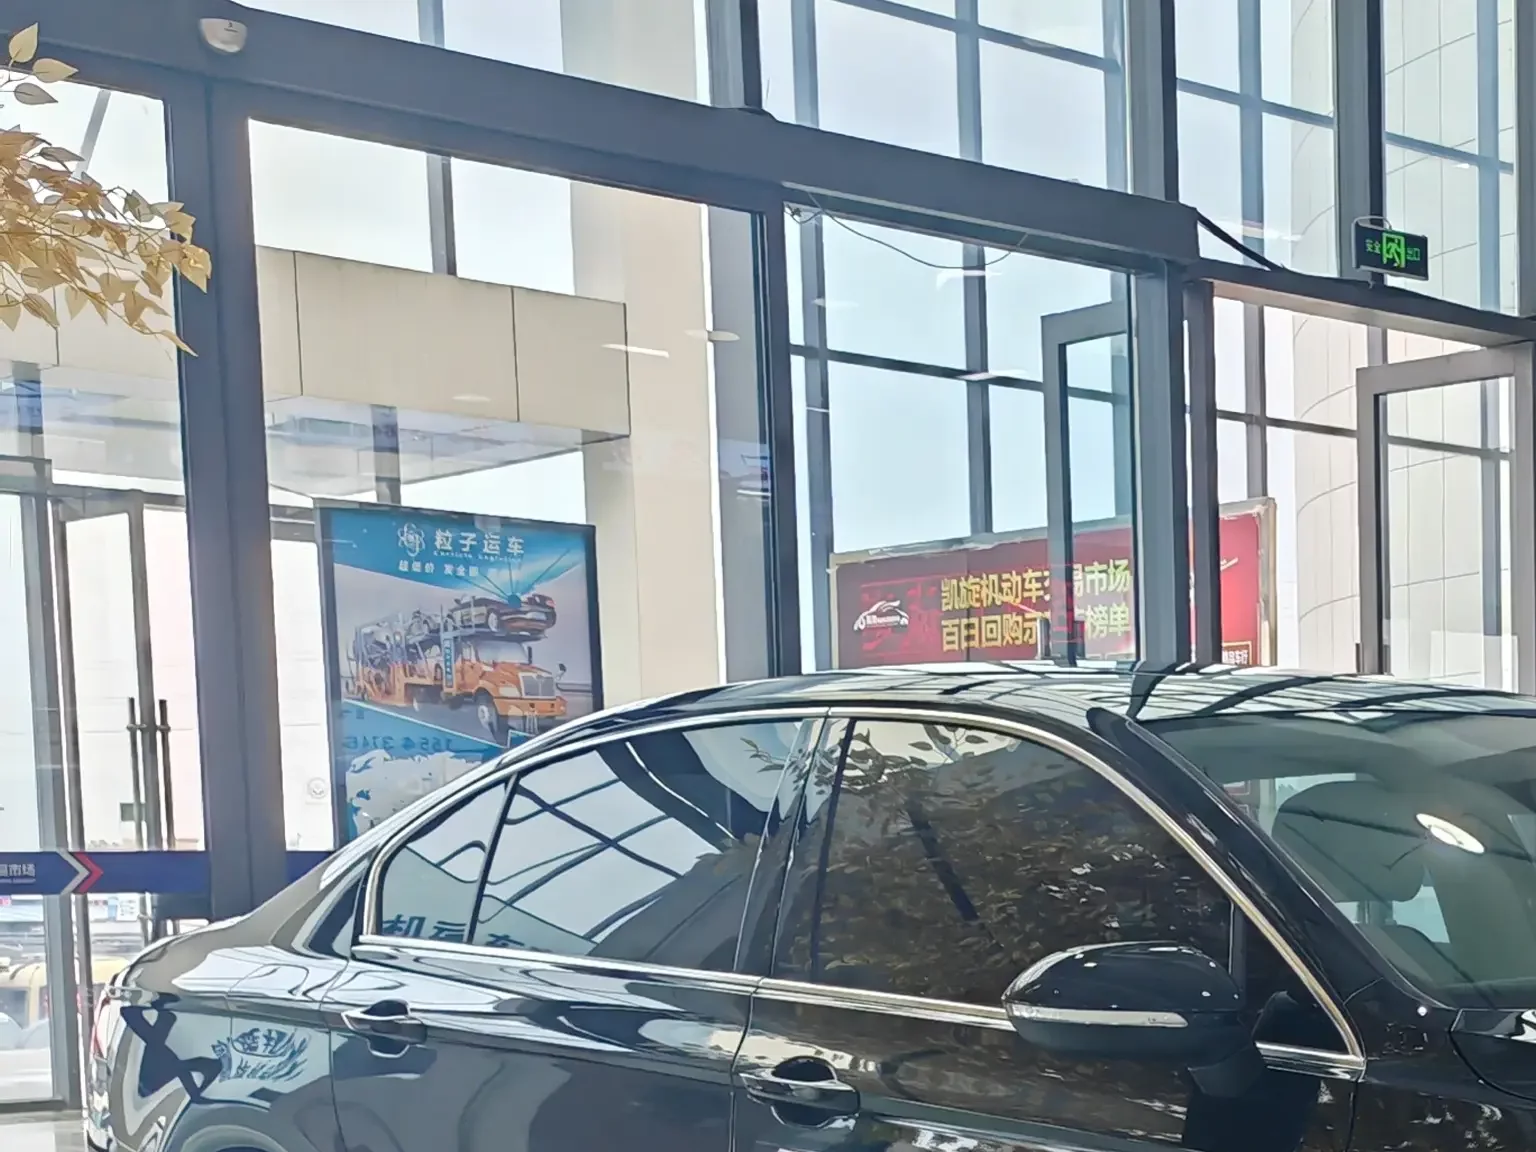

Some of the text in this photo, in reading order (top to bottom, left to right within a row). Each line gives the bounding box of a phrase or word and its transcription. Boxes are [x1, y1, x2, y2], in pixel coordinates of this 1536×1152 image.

[941, 558, 1131, 611] 凯旋机动车市场
